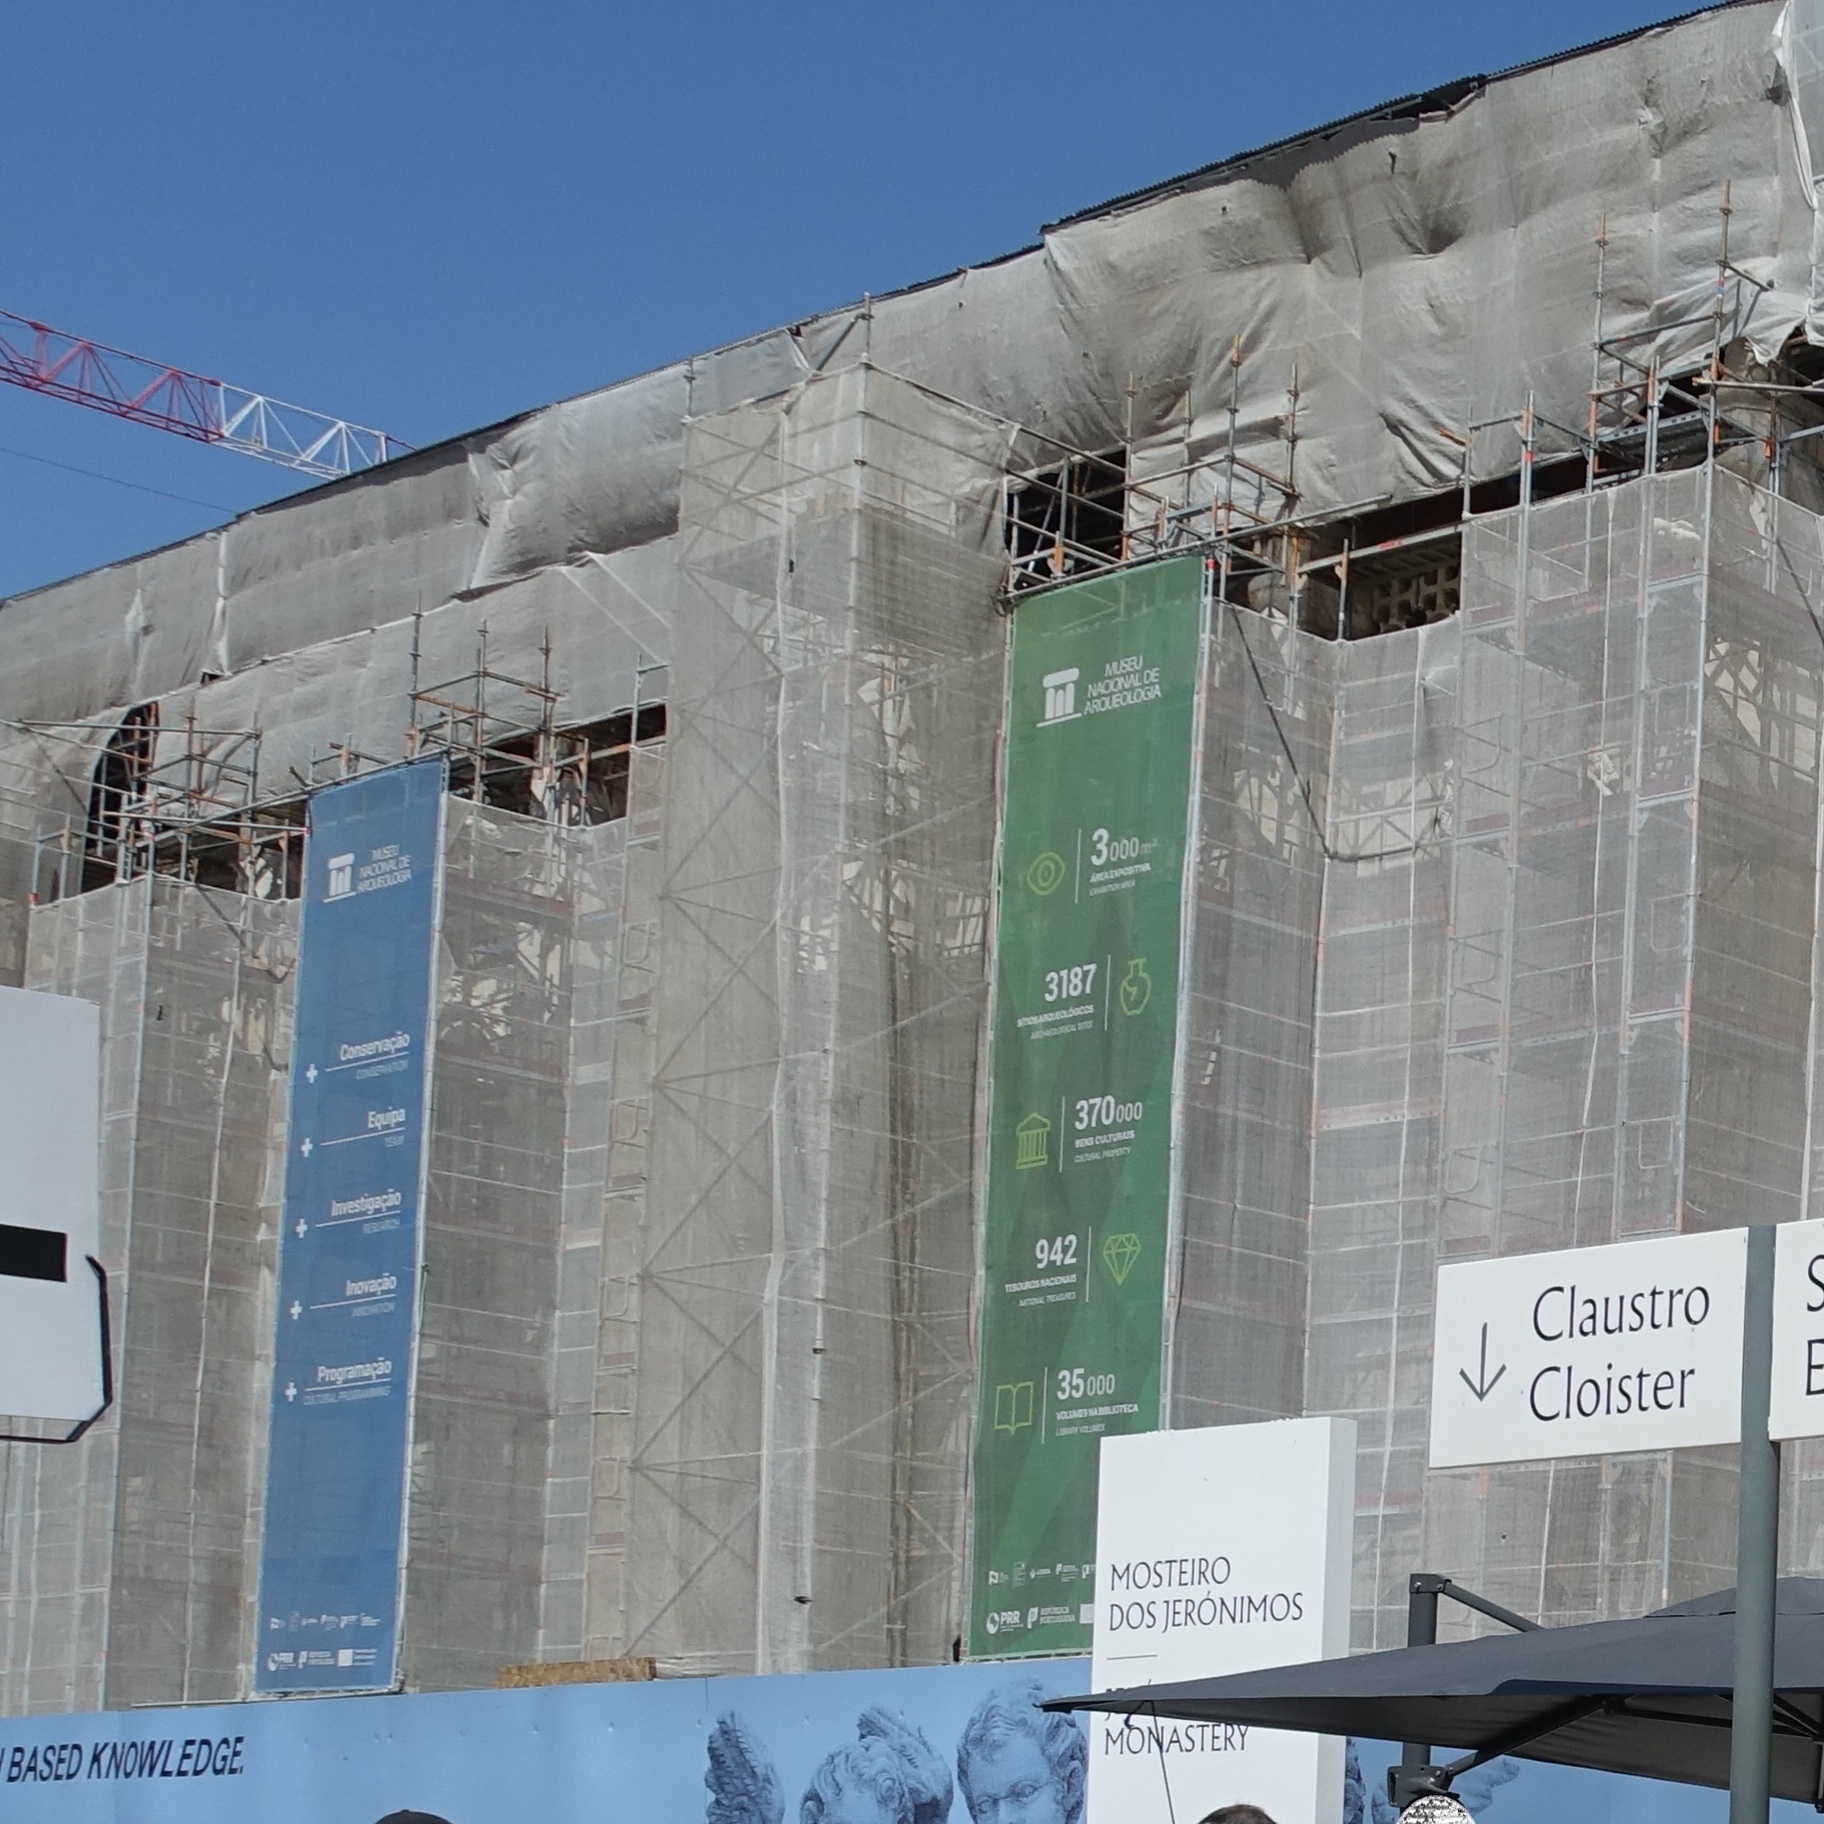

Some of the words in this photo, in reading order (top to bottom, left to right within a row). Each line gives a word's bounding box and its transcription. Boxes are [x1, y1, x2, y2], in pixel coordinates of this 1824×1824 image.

[1104, 655, 1143, 677] MUSEU
[1087, 673, 1142, 698] NACIONAL
[1143, 668, 1160, 684] DE
[1083, 684, 1162, 715] ARQUEOLOGIA
[1044, 963, 1098, 1002] 3187
[340, 1031, 410, 1061] Conservação
[368, 1107, 406, 1130] Equipa
[331, 1188, 402, 1217] Investigação
[1035, 1234, 1078, 1269] 942
[345, 1272, 397, 1297] Inovação
[1532, 1284, 1711, 1342] Claustro
[318, 1356, 392, 1384] Programação
[1529, 1361, 1696, 1422] Cloister
[1110, 1556, 1231, 1591] MOSTEIRO
[1001, 1610, 1020, 1625] PRR
[1109, 1602, 1157, 1632] DOS
[1161, 1591, 1304, 1633] JERÓNIMOS
[1104, 1724, 1250, 1756] MONASTERY
[6, 1743, 83, 1783] BASED
[87, 1736, 244, 1780] KNOWLEDGE.
